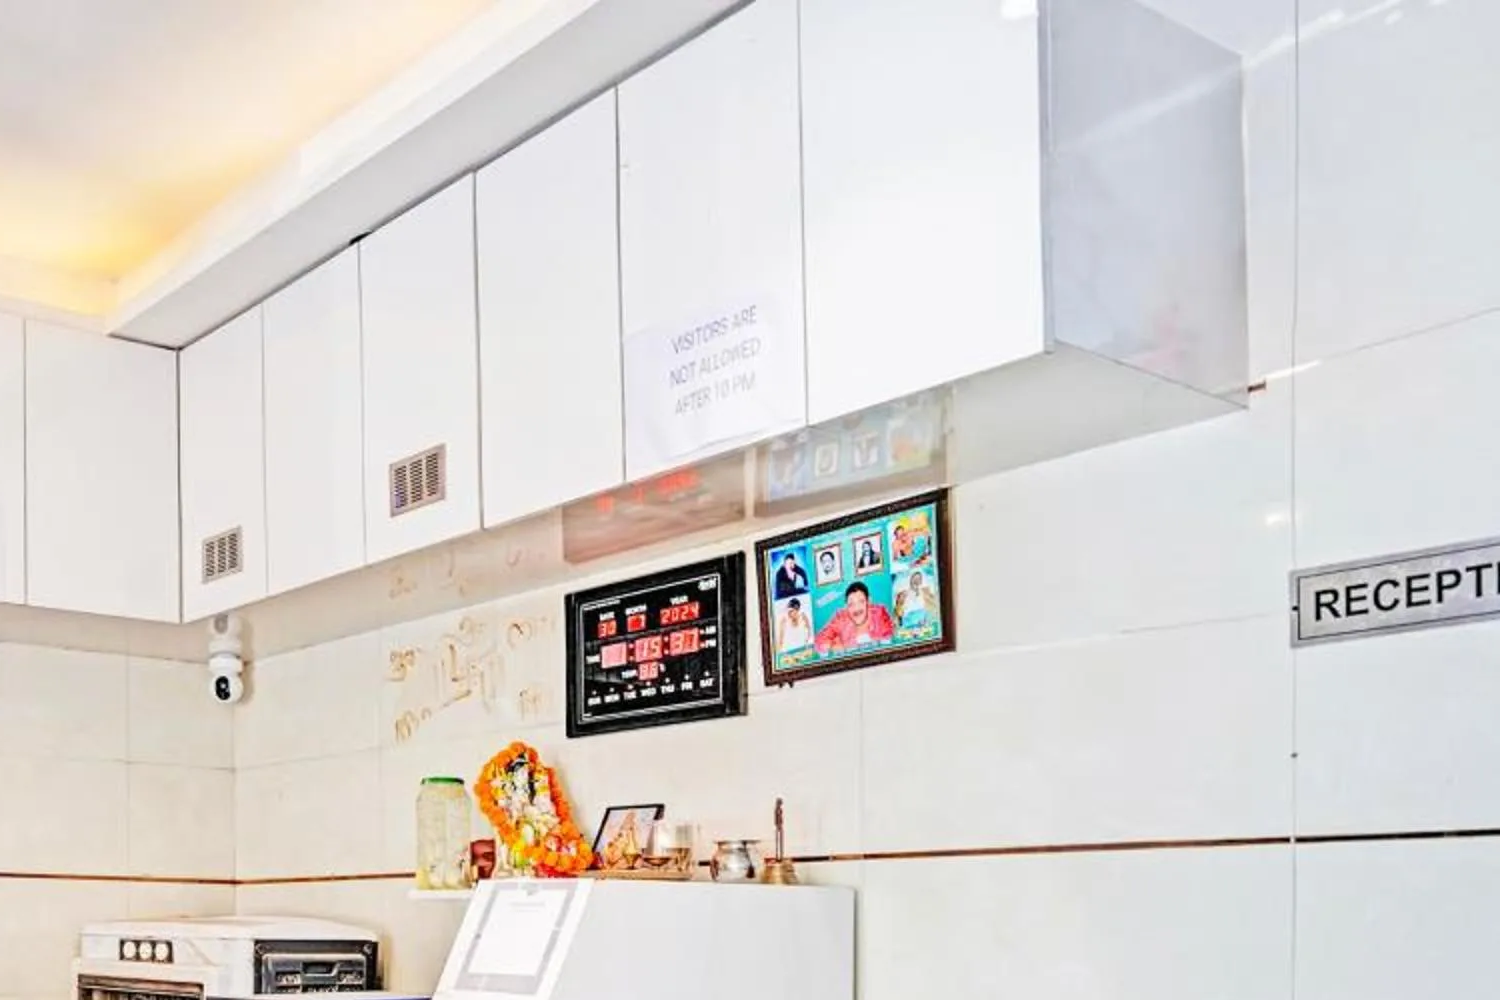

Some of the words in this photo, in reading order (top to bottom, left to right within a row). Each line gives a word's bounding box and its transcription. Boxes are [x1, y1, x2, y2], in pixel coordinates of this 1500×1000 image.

[672, 318, 728, 354] VISITORS
[731, 304, 757, 331] ARE
[668, 361, 696, 387] NOT
[699, 337, 761, 376] ALLOWED
[674, 386, 712, 415] AFTER
[660, 601, 700, 625] 2024
